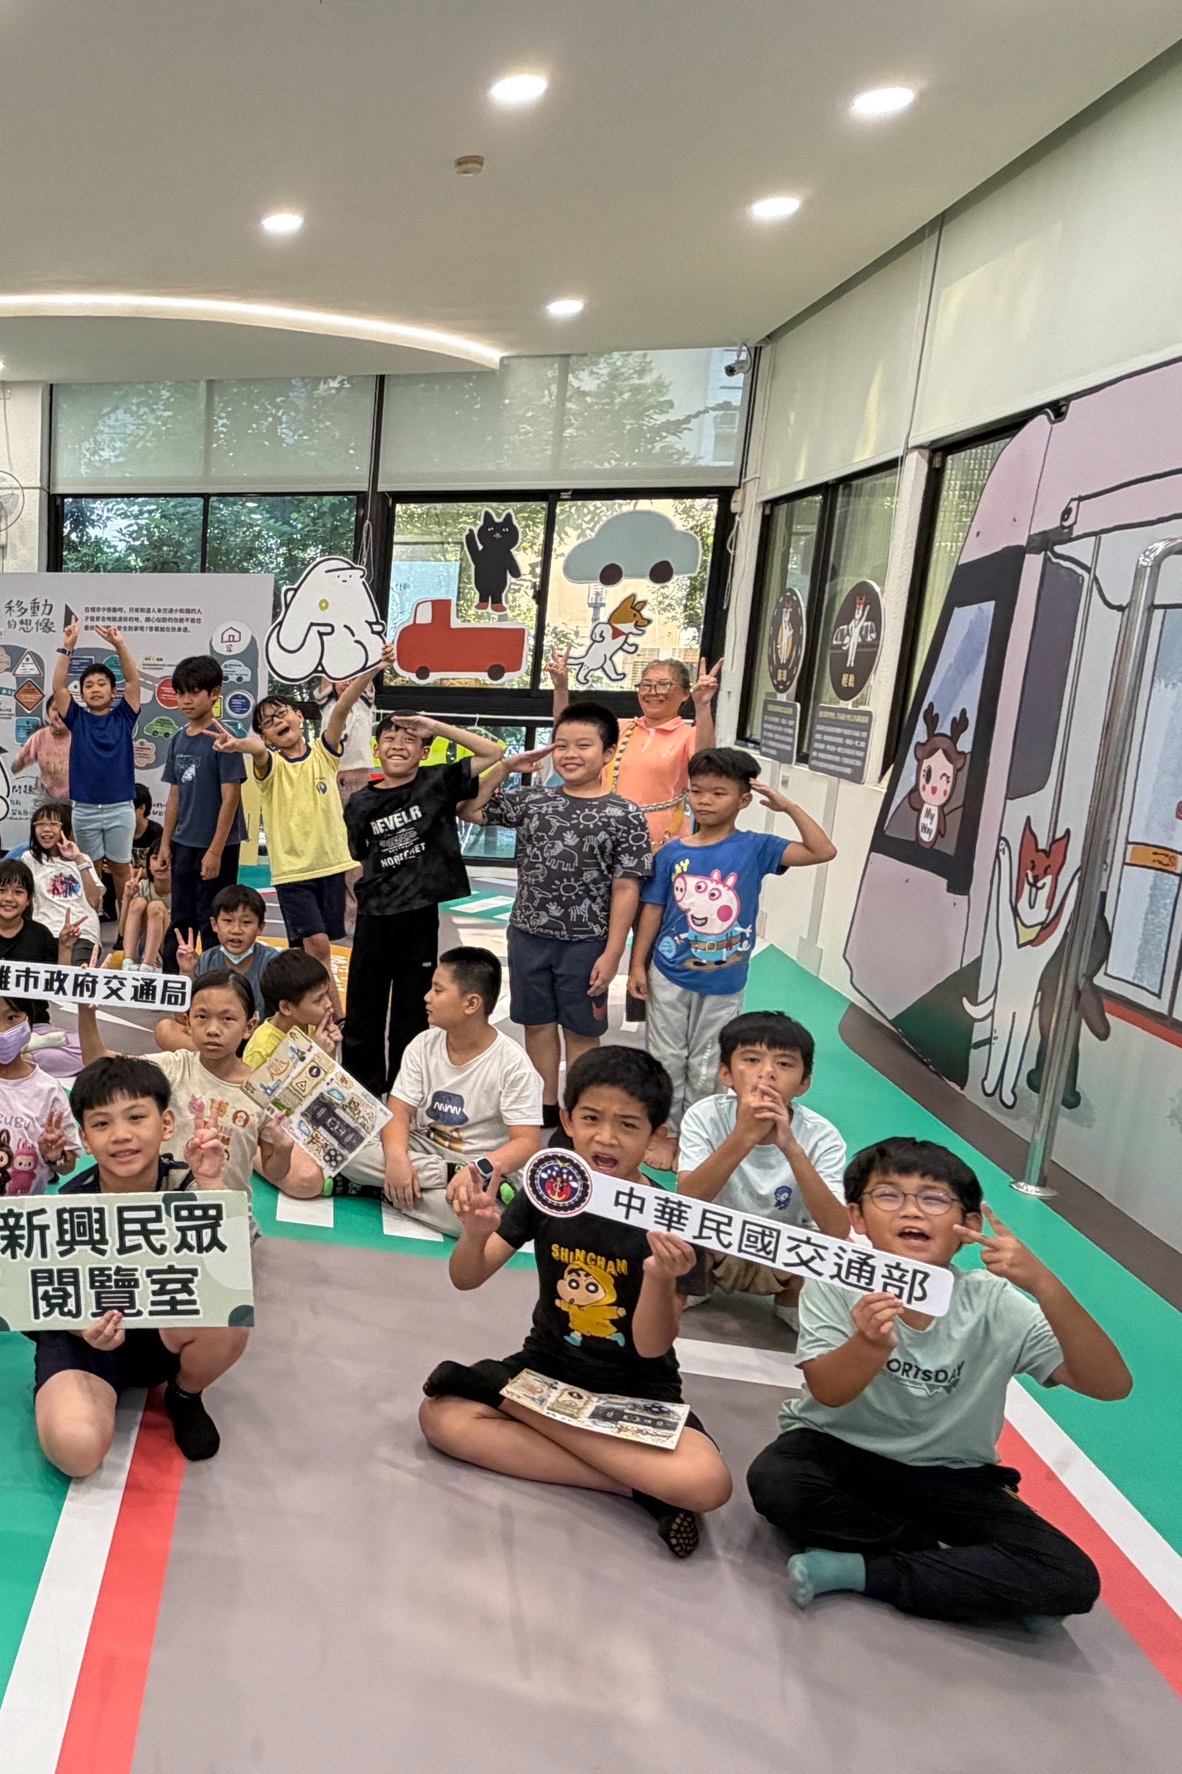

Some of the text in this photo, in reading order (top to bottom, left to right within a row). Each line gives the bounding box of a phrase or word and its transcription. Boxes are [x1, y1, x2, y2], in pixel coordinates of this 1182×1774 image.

[4, 597, 53, 617] 移動
[7, 618, 56, 633] 的想像
[551, 1243, 629, 1276] SHINCHAN
[612, 1186, 931, 1306] 中華民國交通部
[30, 1264, 202, 1320] 閱覽室
[886, 1358, 965, 1383] ORTSDAY
